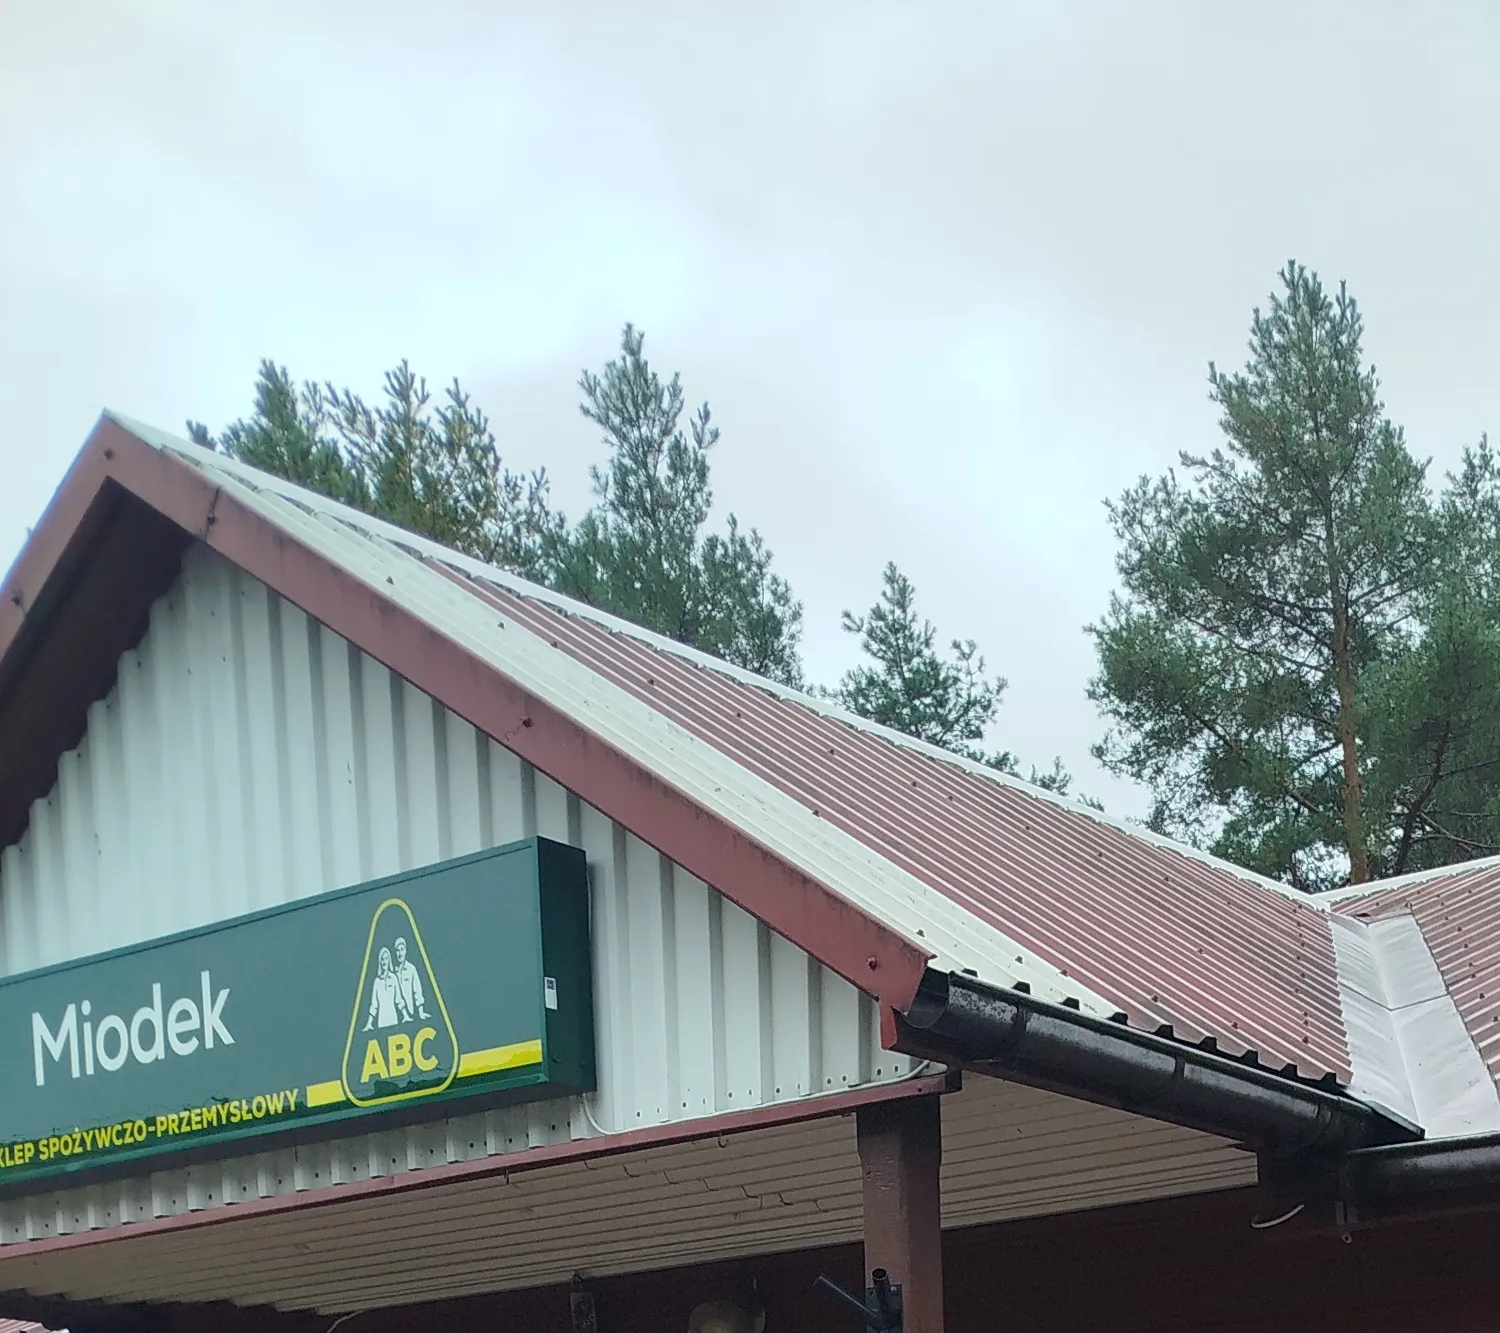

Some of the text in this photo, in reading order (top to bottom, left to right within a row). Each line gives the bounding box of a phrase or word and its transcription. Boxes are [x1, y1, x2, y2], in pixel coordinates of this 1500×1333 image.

[32, 970, 236, 1086] Miodek
[360, 1027, 439, 1083] ABC
[38, 1088, 299, 1160] SPOŻYWCZO-PRZEMYSŁOWY
